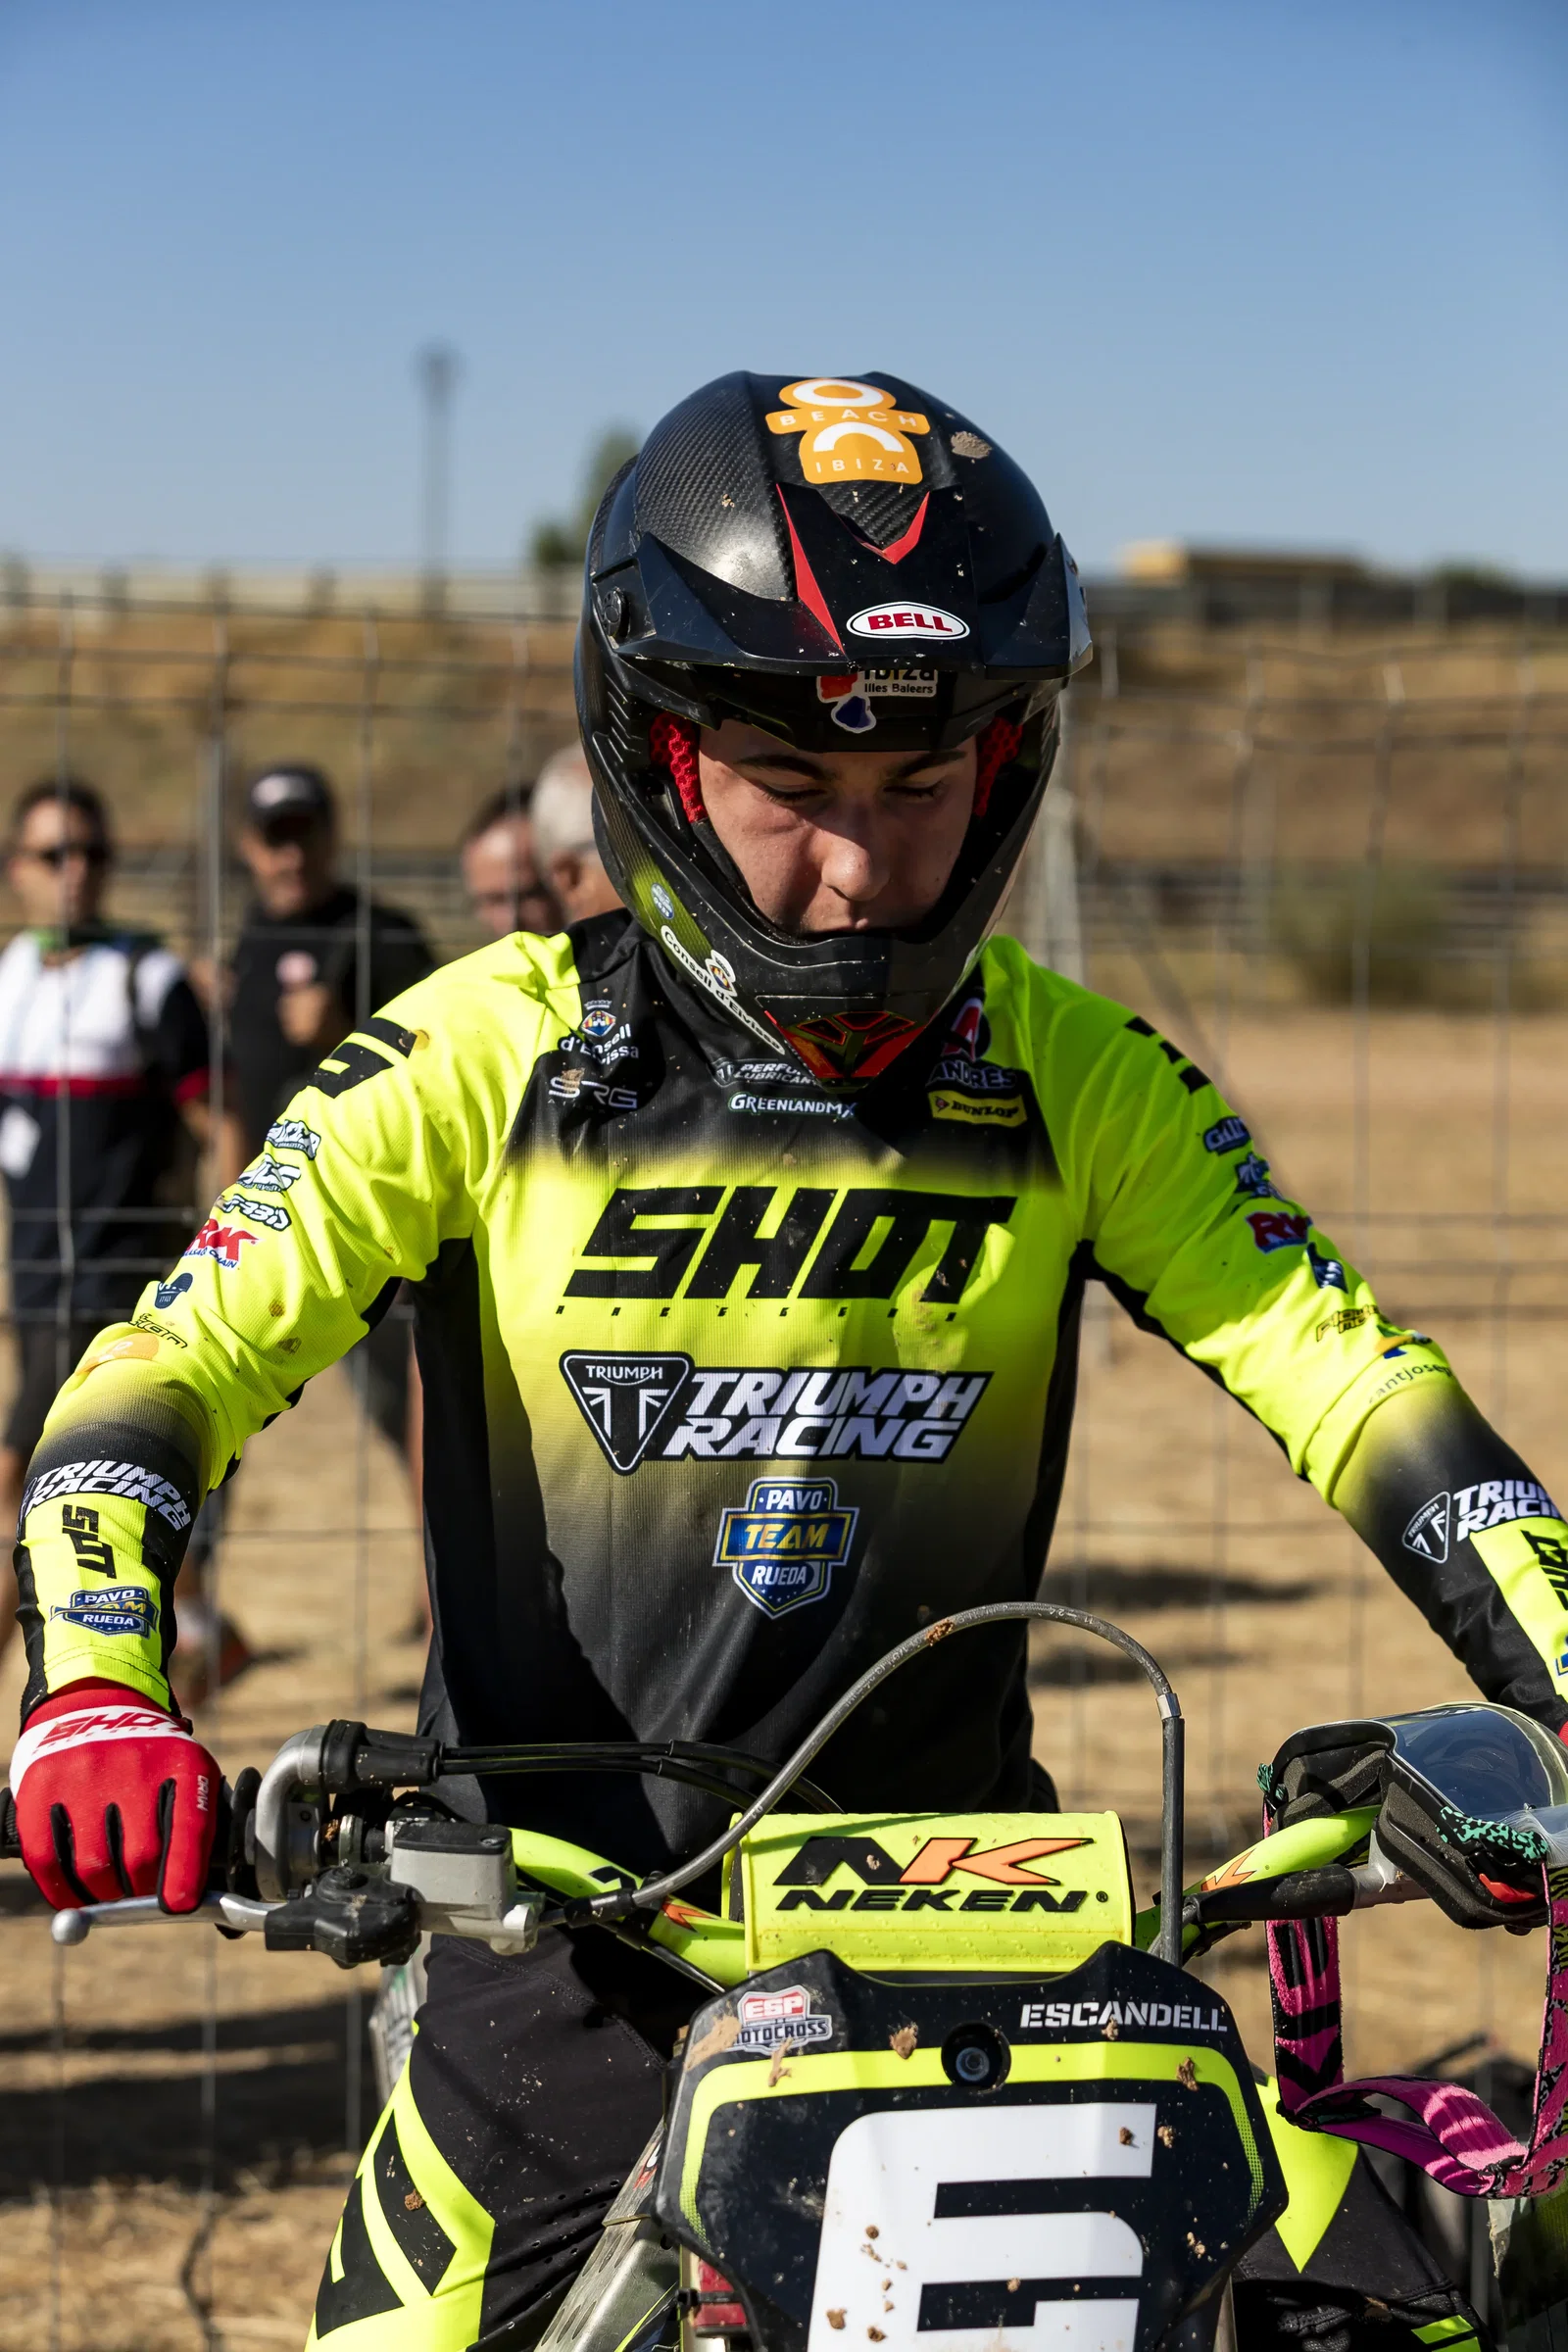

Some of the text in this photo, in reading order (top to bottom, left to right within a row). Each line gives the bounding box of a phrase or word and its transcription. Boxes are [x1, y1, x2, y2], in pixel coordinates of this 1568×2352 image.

[780, 409, 917, 427] BEACH
[814, 458, 910, 475] IBIZA
[867, 612, 954, 633] BELL
[863, 683, 934, 694] Illes Balears
[662, 929, 713, 989] Consell
[951, 1100, 1020, 1119] DUNLOP
[564, 1185, 1017, 1304] SHOT
[585, 1365, 663, 1381] TRIUMPH
[690, 1371, 992, 1417] TRIUMPH
[662, 1417, 962, 1459] RACING
[25, 1477, 185, 1532] RACING
[35, 1459, 191, 1527] TRIUMPH
[766, 1489, 824, 1511] PAVO
[745, 1522, 828, 1549] TEAM
[752, 1565, 807, 1586] RUEDA
[84, 1589, 135, 1604] PAVO
[82, 1614, 134, 1627] RUEDA
[774, 1888, 1087, 1913] NEKEN
[745, 1995, 804, 2019] ESP
[1020, 2002, 1228, 2032] ESCANDELL
[736, 2021, 827, 2045] OTOCROSS
